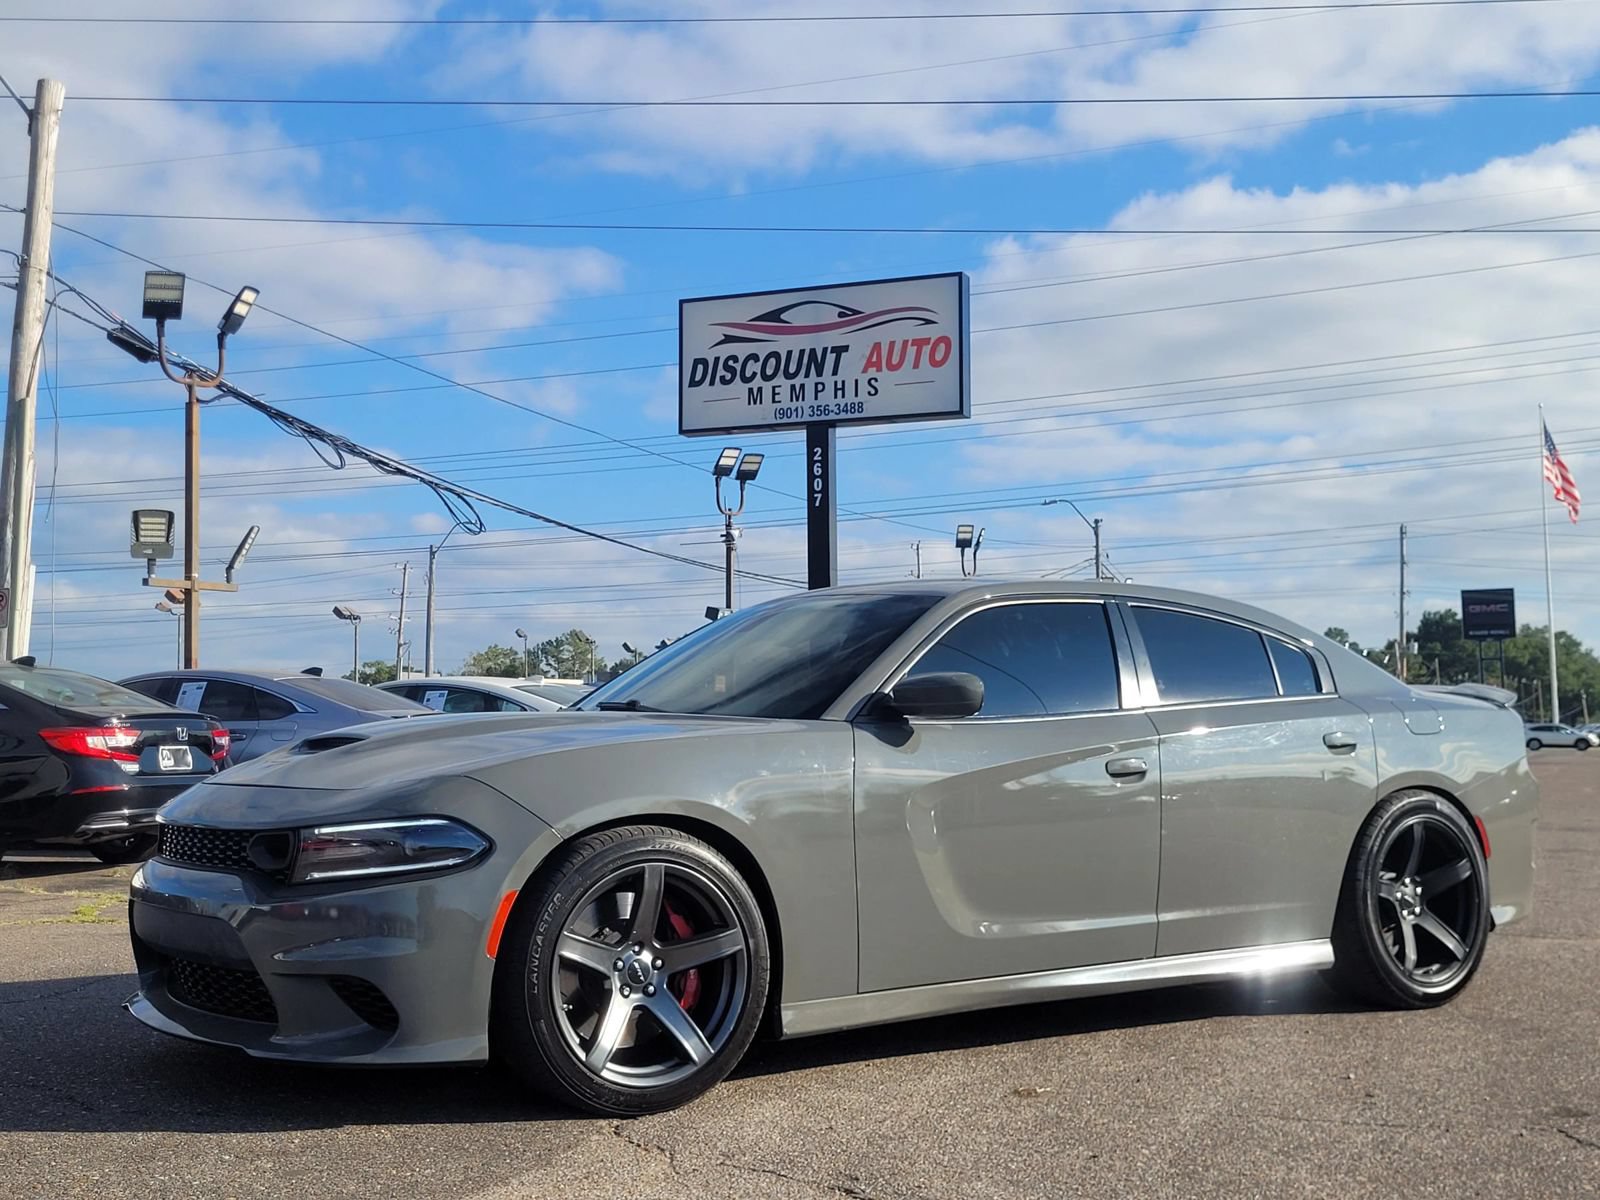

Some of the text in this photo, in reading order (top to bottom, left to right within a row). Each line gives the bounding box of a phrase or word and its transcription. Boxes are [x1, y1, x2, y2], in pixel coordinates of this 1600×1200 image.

[688, 335, 952, 388] DISCOUNT AUTO
[747, 377, 879, 406] MEMPHIS
[774, 401, 865, 421] (901) 356-3488
[813, 447, 822, 507] 2607
[1468, 604, 1509, 613] GMC
